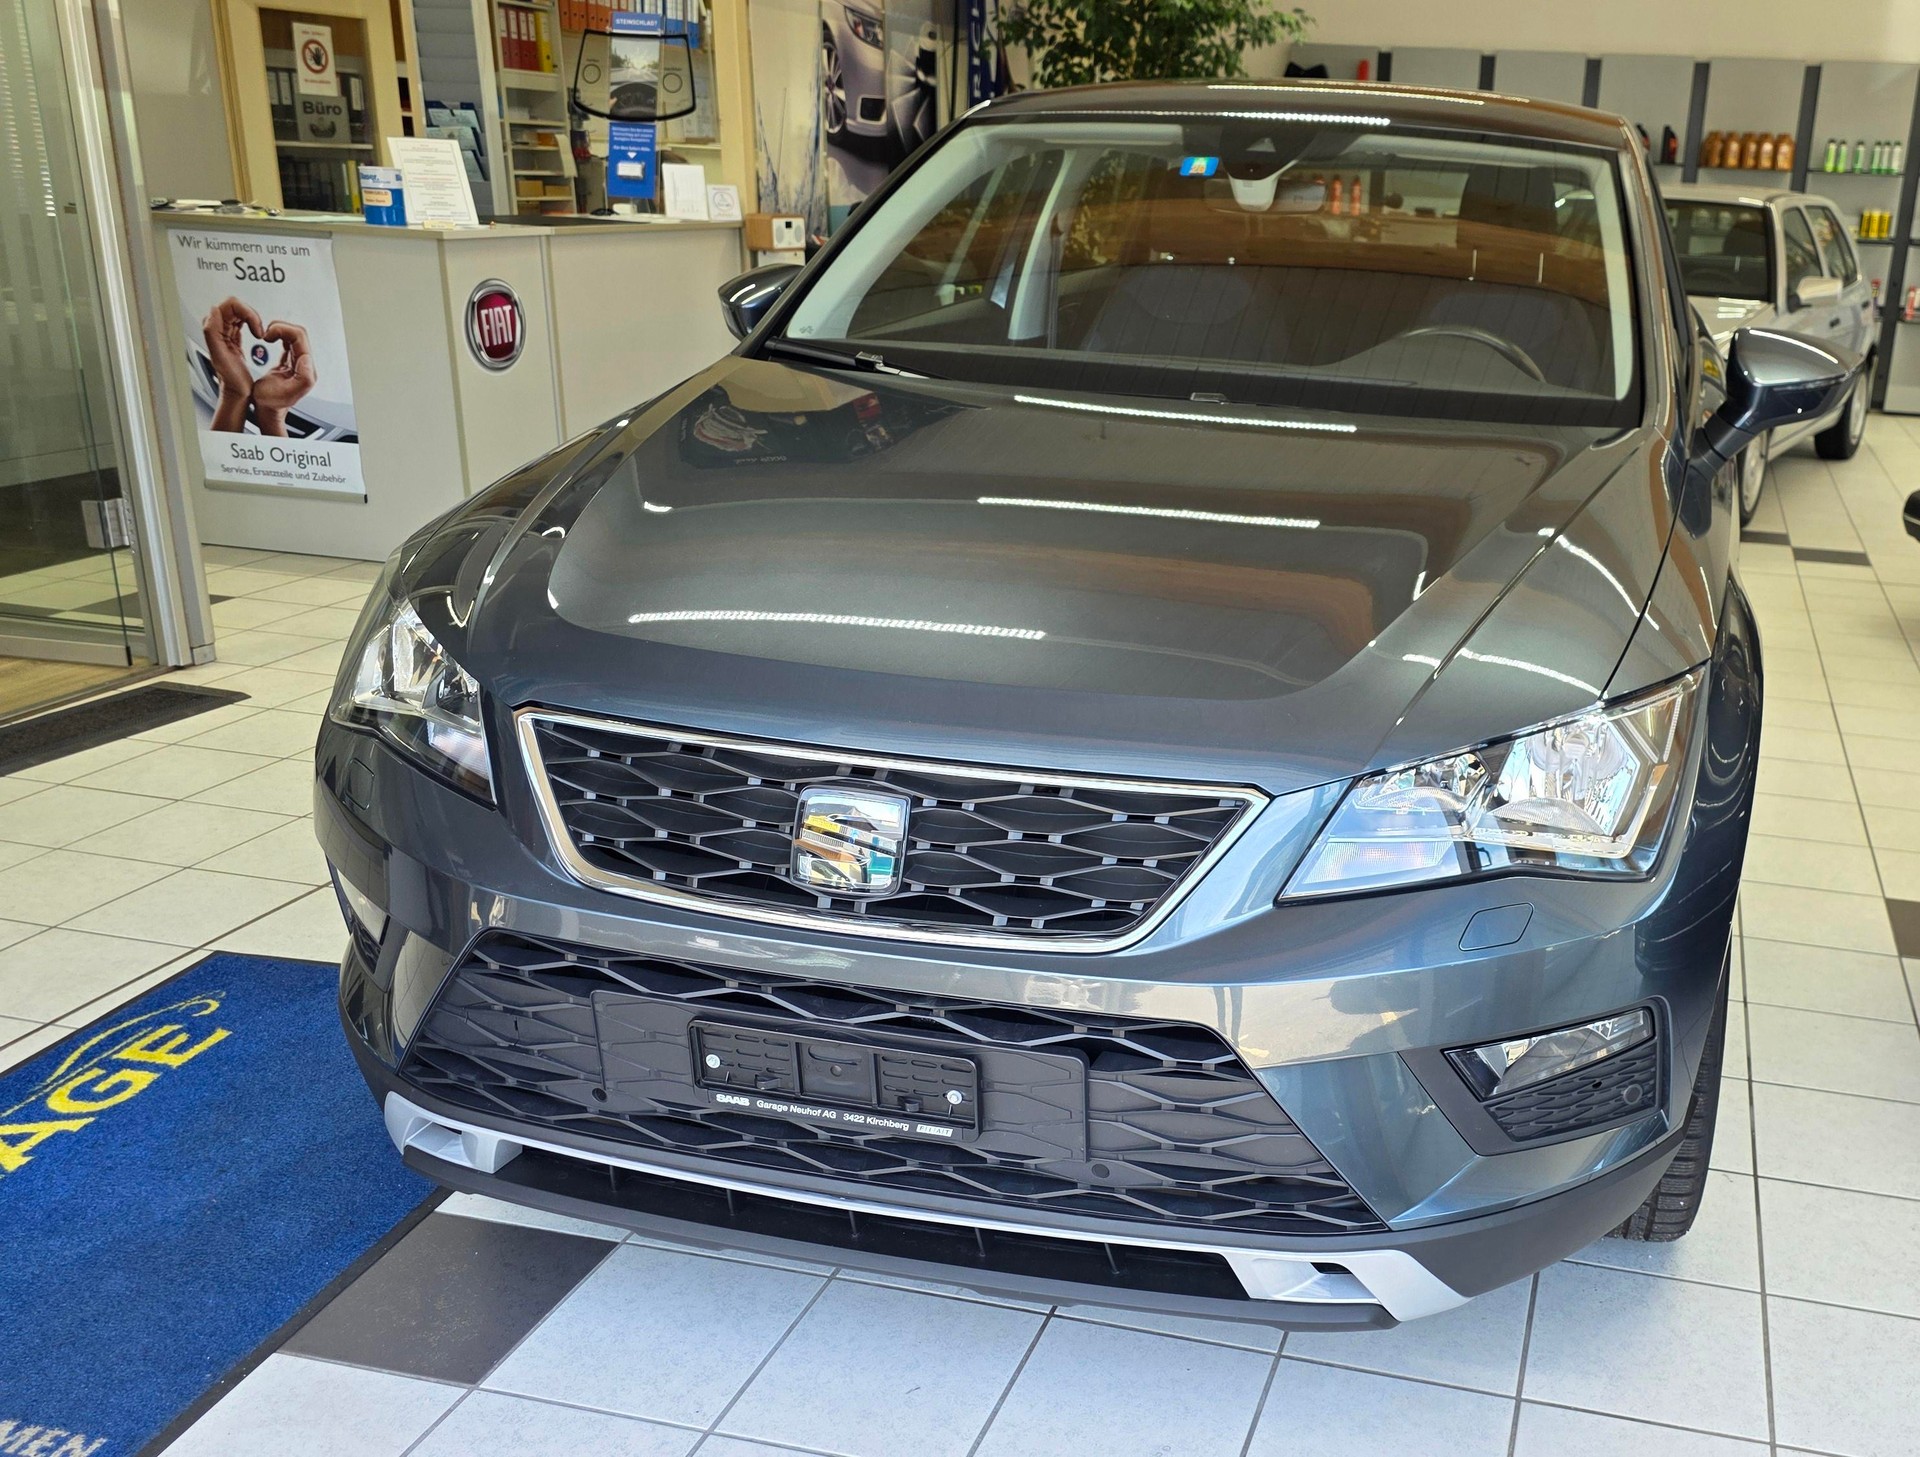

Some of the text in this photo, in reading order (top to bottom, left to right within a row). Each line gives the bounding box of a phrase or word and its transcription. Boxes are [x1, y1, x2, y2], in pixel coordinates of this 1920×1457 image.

[303, 100, 342, 115] Büro
[177, 234, 311, 256] Wir kümmern uns um
[197, 256, 285, 283] Ihren Saab
[481, 304, 513, 347] FIAT
[231, 443, 332, 469] Saab Original
[253, 467, 293, 479] Ersatzteile
[295, 470, 310, 481] und
[313, 472, 346, 484] Zubehör
[716, 1093, 953, 1137] SAAB Garage Neuhof AG 3422 Kirchberg FIAT
